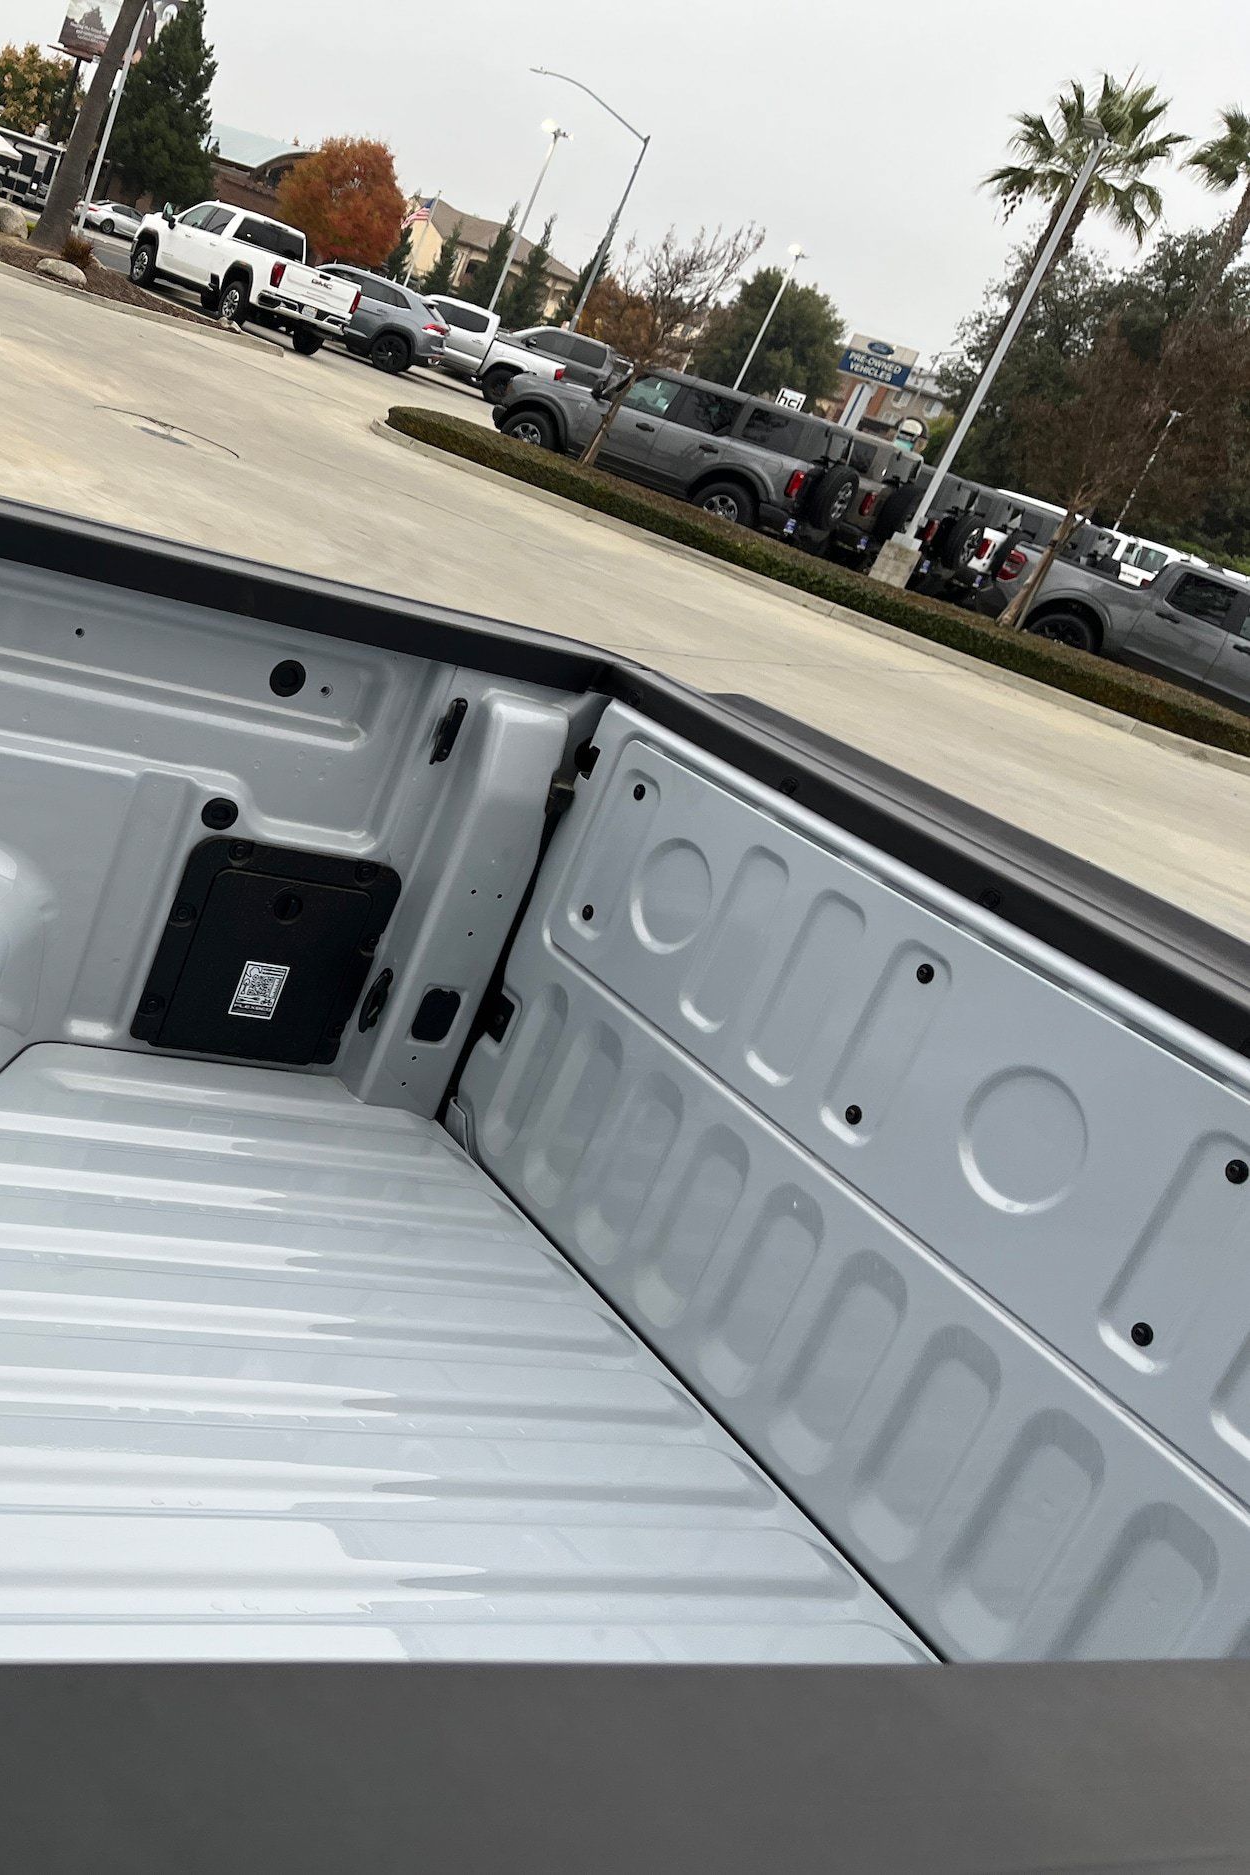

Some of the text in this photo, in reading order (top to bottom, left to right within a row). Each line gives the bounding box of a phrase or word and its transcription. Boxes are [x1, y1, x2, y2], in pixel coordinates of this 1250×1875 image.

[311, 278, 334, 290] GMC
[848, 351, 903, 375] PRE-OWNED
[849, 361, 893, 382] VEHICLES
[777, 390, 803, 409] hci
